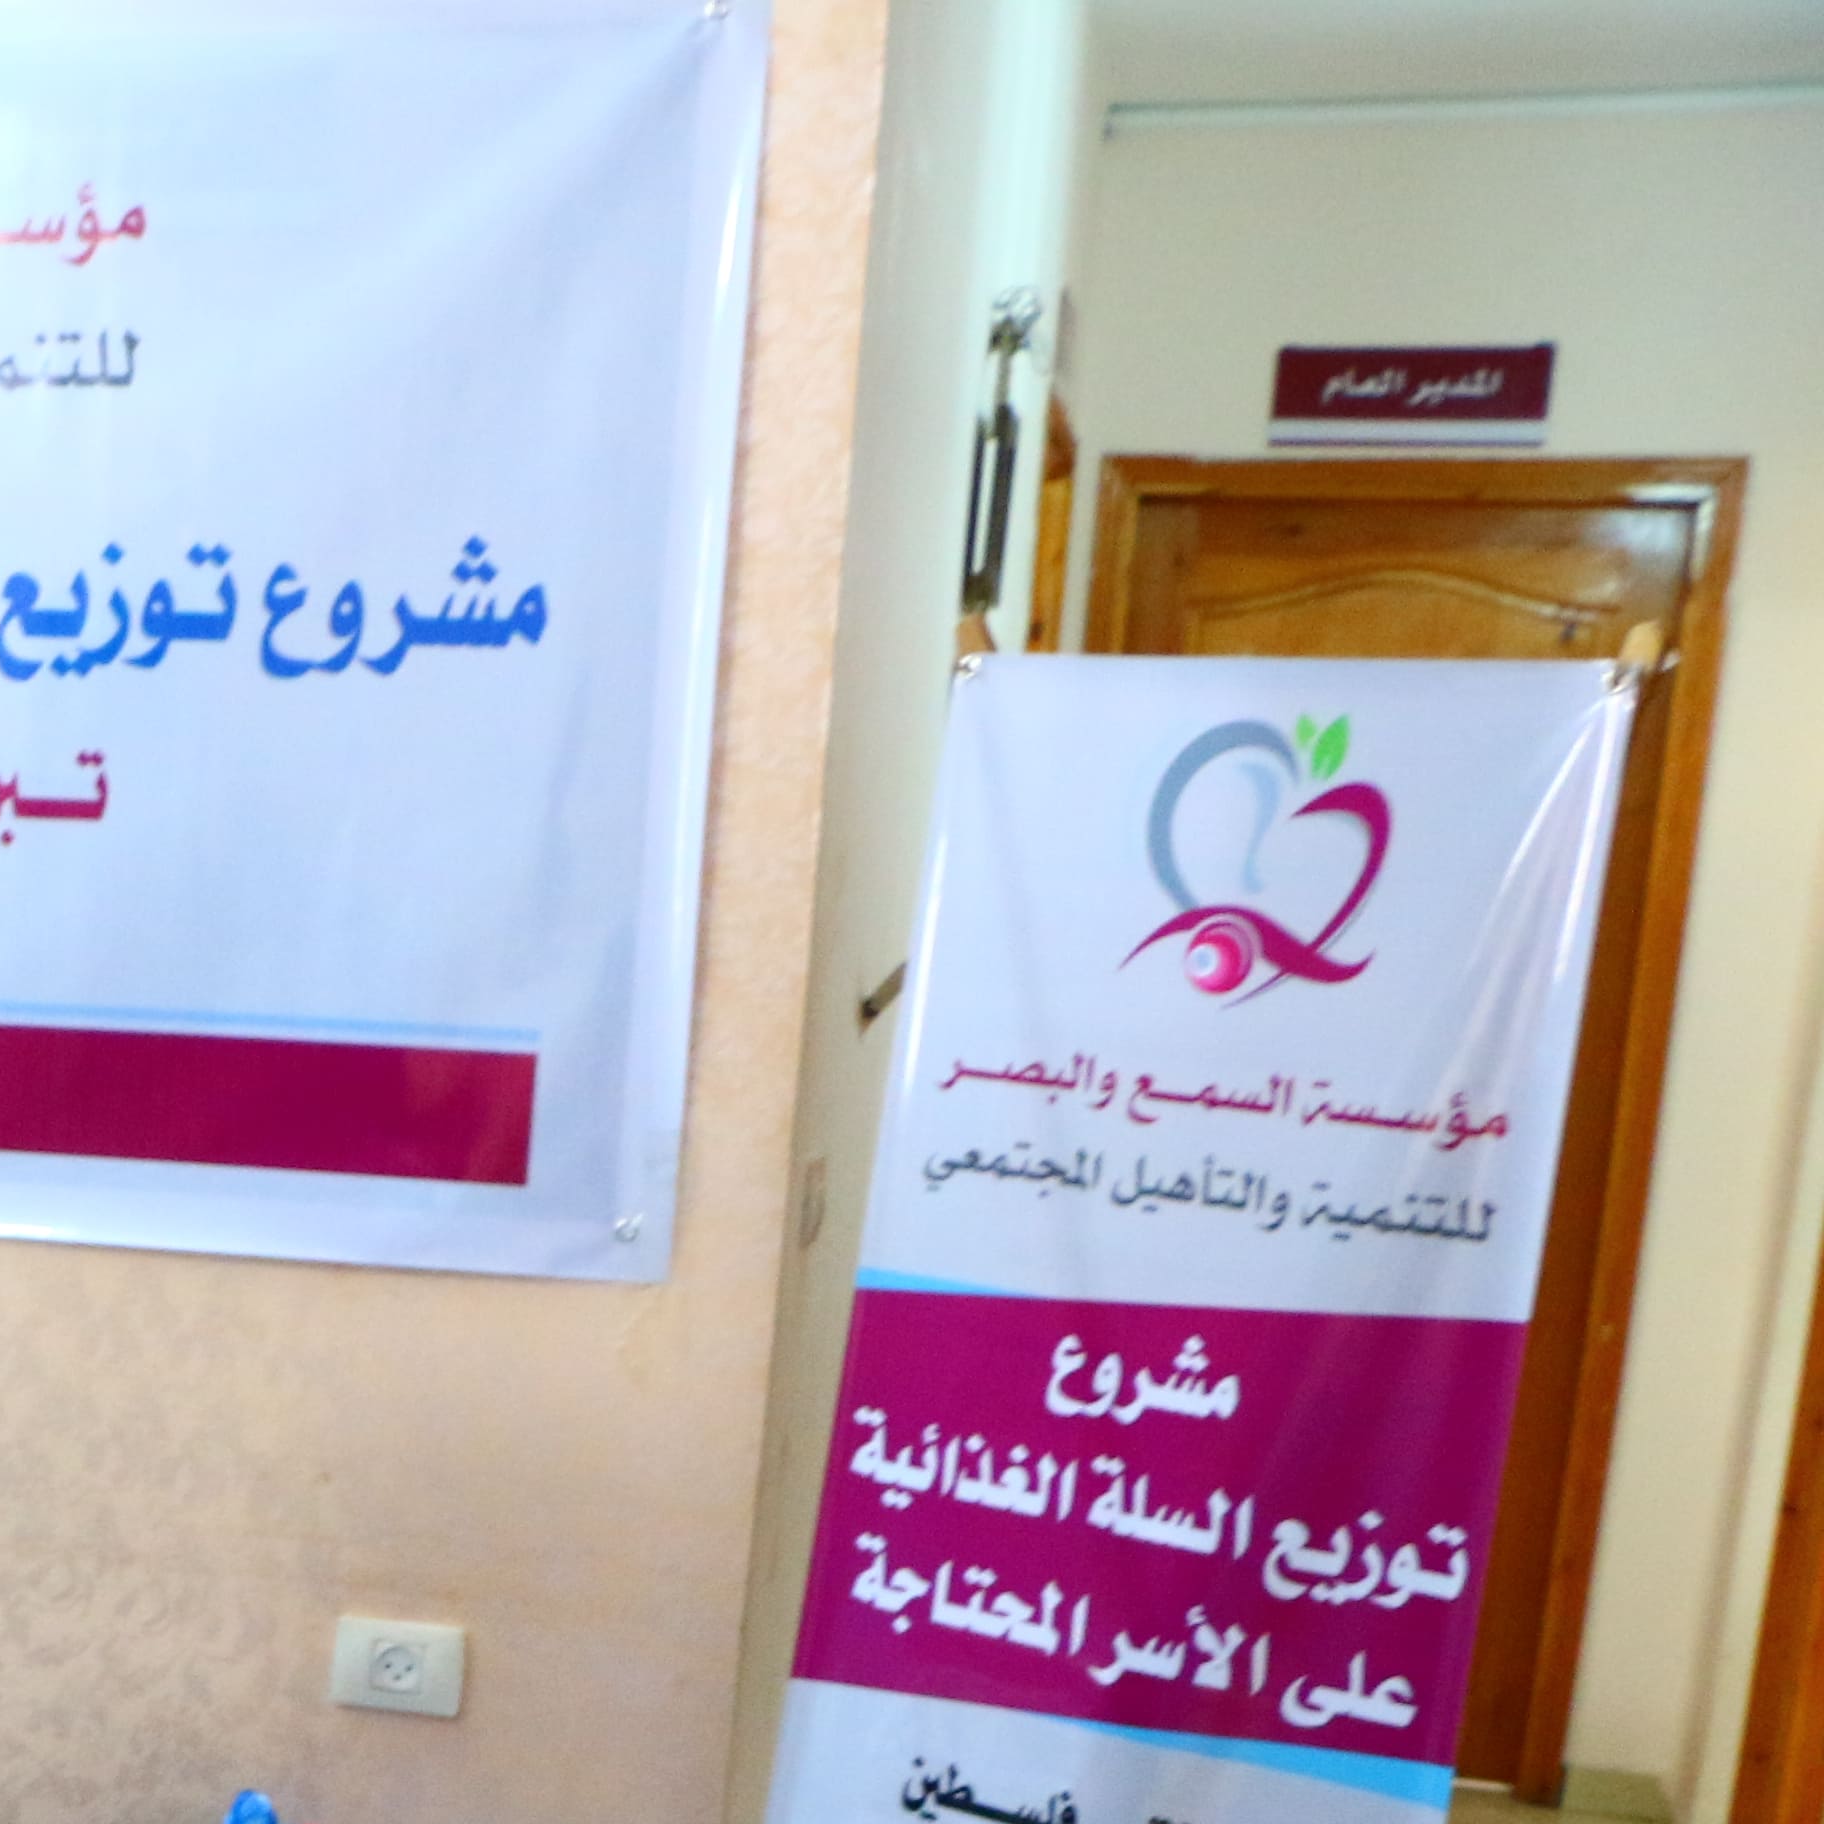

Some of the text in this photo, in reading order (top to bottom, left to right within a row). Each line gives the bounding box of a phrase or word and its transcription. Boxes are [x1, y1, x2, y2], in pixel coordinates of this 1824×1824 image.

[259, 535, 548, 680] مشروع
[939, 1053, 1509, 1152] مؤسسة السمع والبصر
[922, 1142, 1497, 1244] للتنمية والتأهيل المجتمعي
[1044, 1333, 1240, 1425] مشروع
[849, 1406, 1469, 1609] توزيع السلة الغذائية
[850, 1531, 1417, 1727] على الأسر المحتاجة
